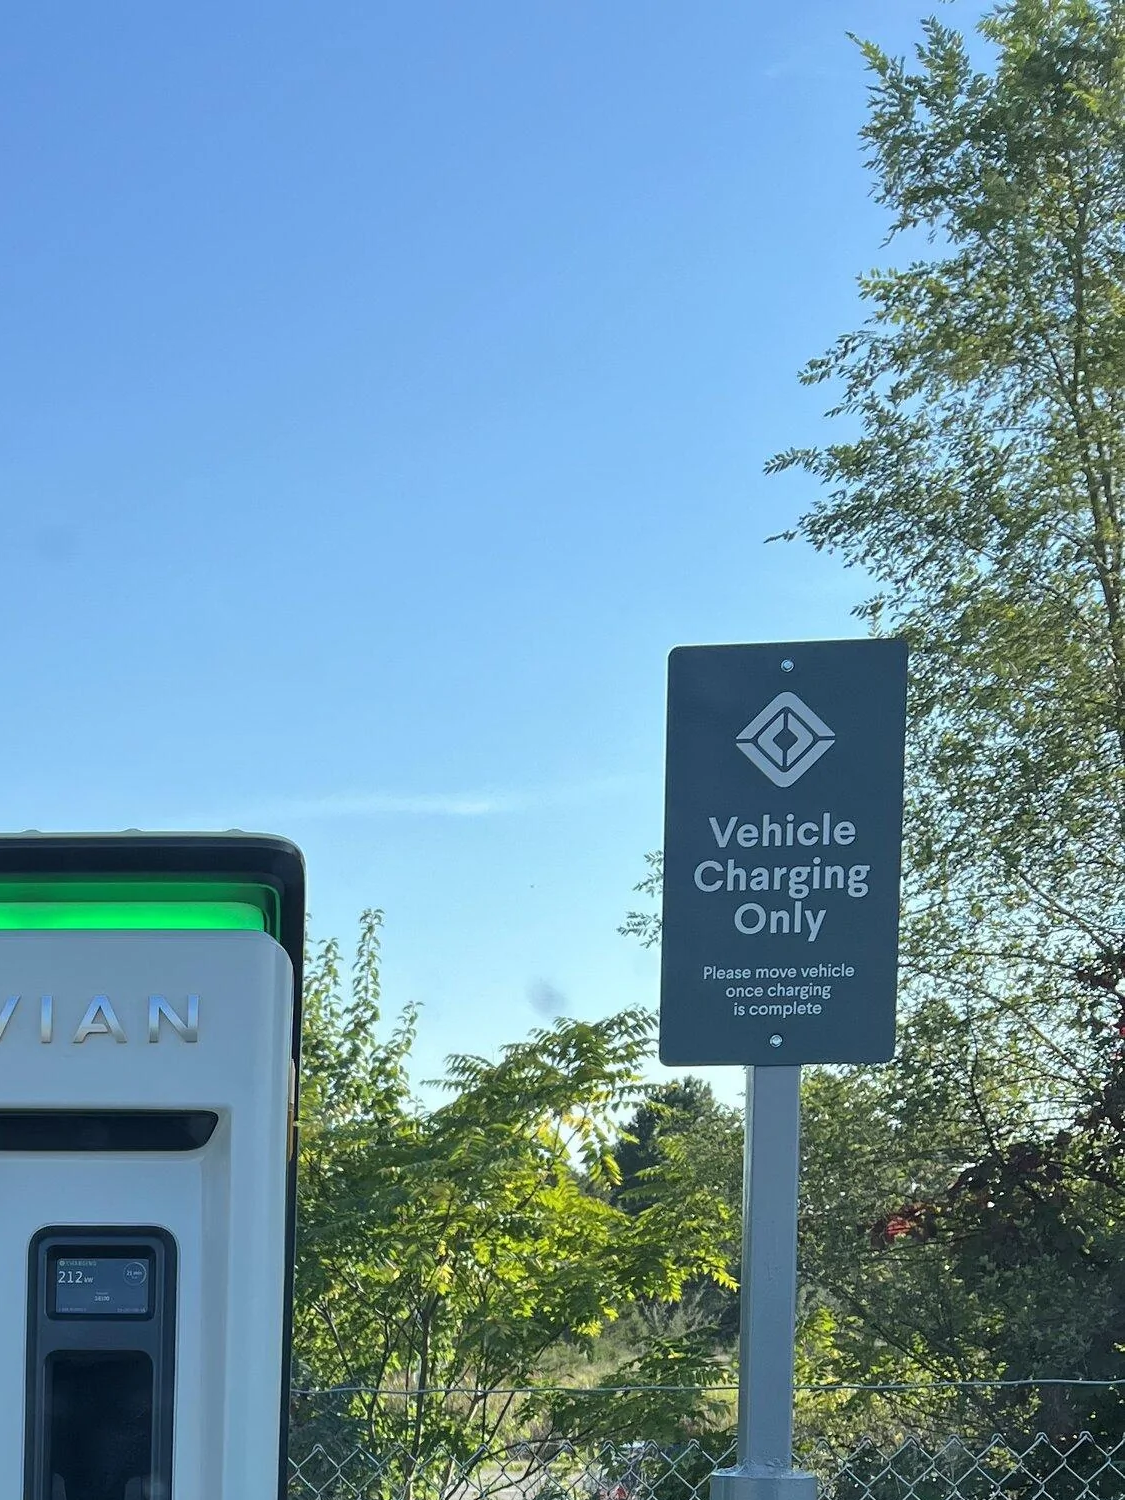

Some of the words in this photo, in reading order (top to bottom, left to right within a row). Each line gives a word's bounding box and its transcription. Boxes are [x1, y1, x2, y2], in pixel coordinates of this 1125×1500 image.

[708, 812, 856, 848] Vehicle
[694, 856, 871, 900] Charging
[734, 901, 827, 942] Only
[703, 965, 752, 980] Please
[755, 966, 797, 979] move
[800, 963, 855, 978] vehicle
[725, 986, 764, 998] once
[767, 983, 832, 1000] charging
[733, 1003, 746, 1016] is
[749, 1001, 823, 1019] complete
[58, 1270, 83, 1284] 212
